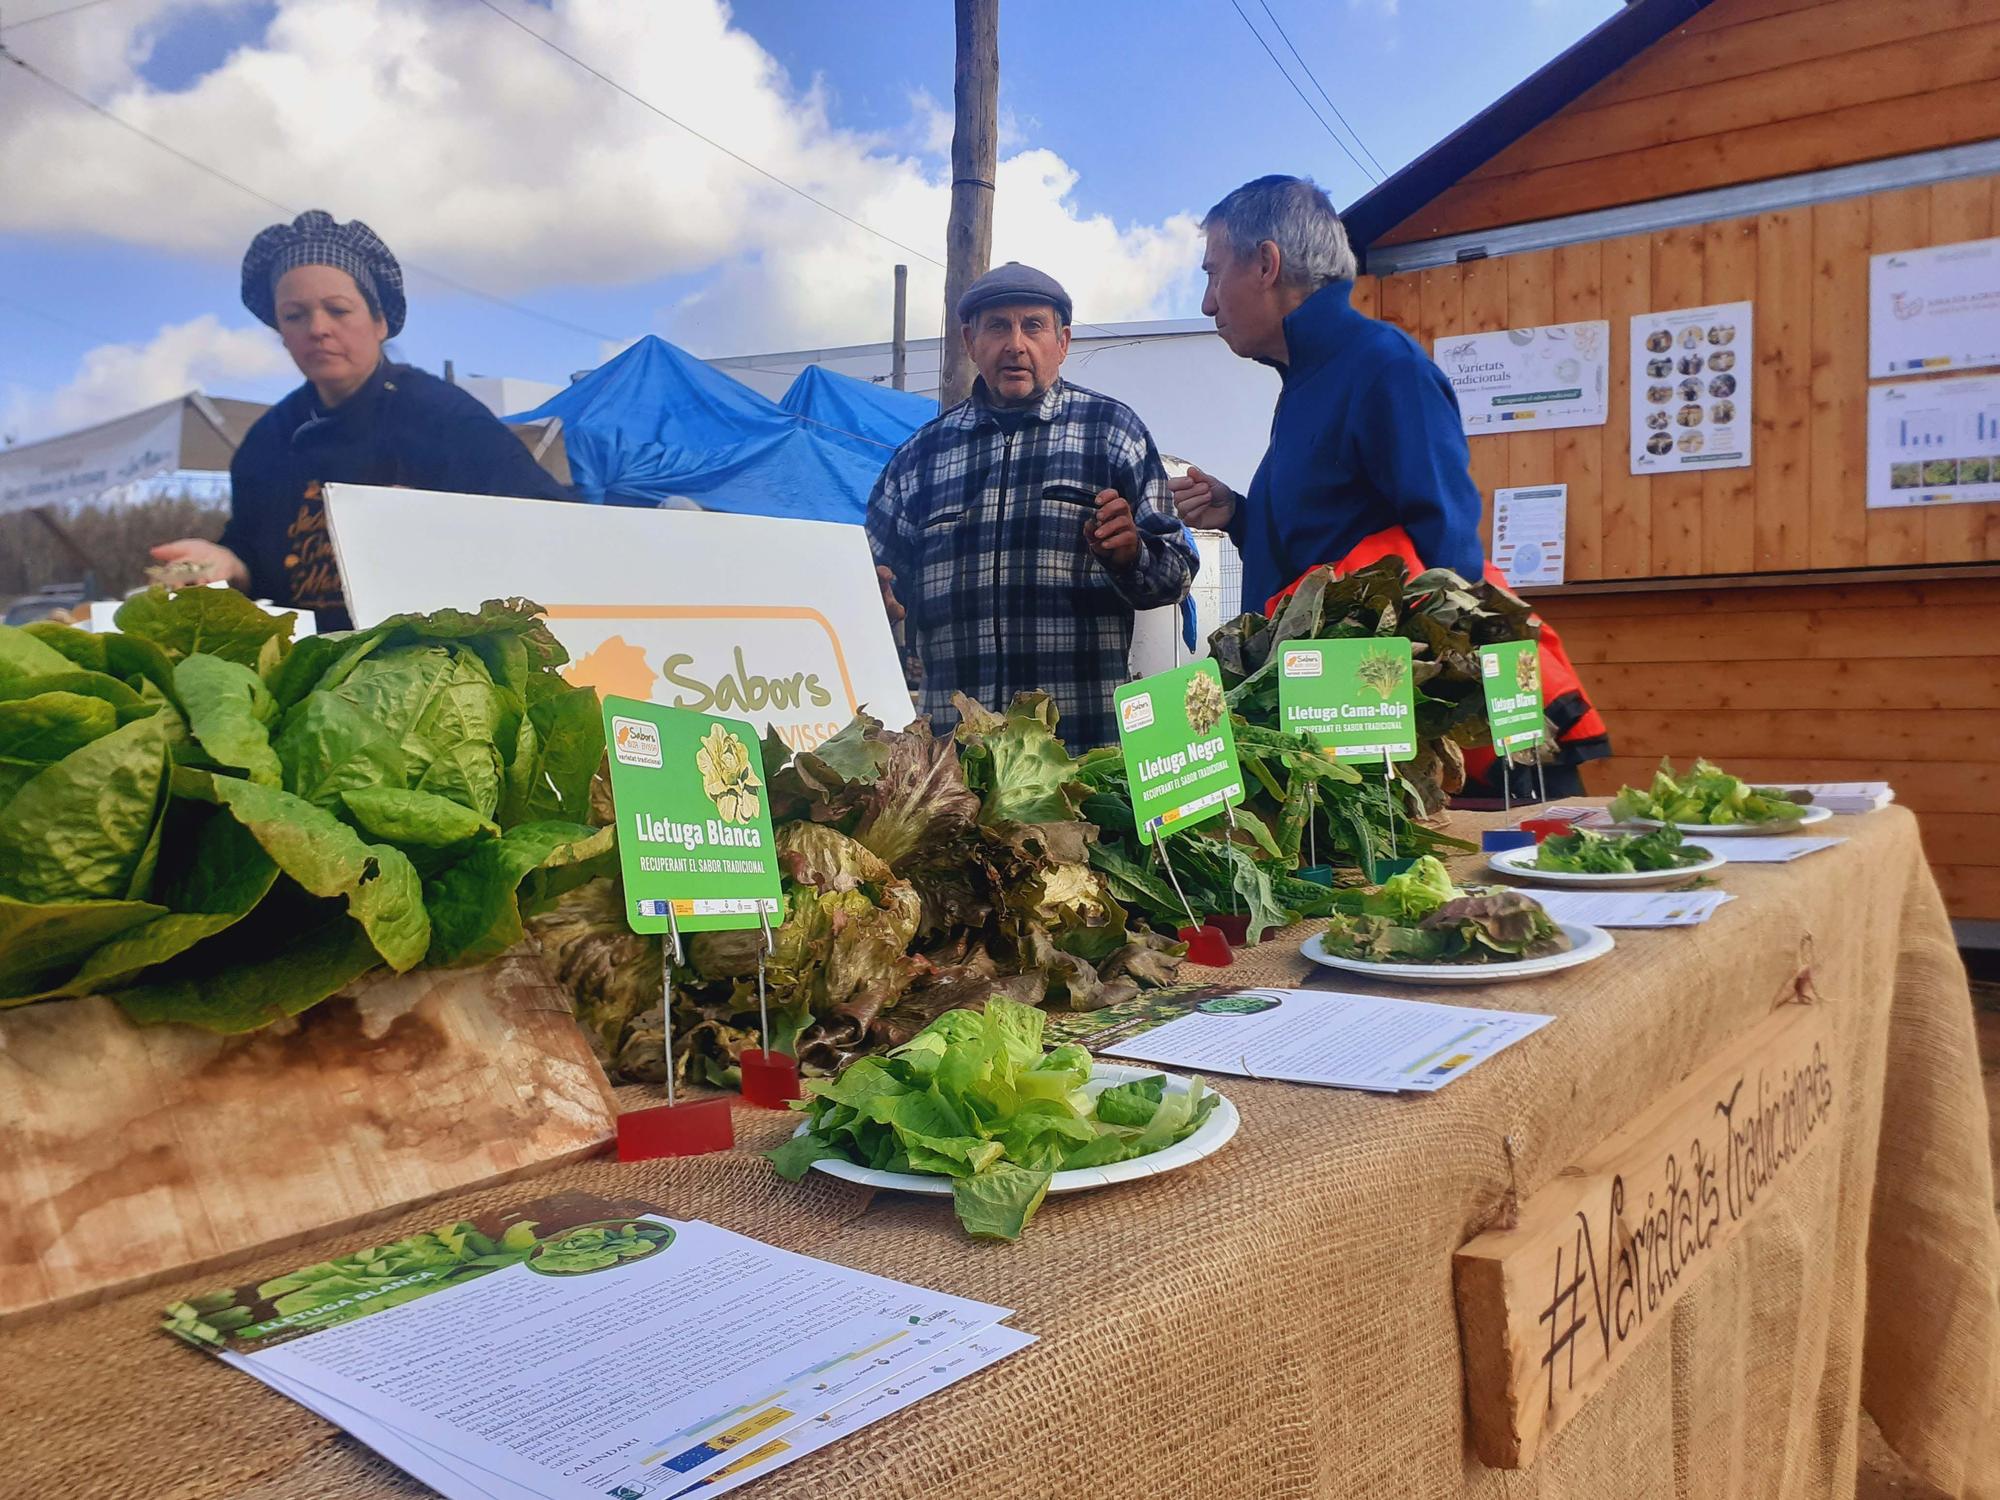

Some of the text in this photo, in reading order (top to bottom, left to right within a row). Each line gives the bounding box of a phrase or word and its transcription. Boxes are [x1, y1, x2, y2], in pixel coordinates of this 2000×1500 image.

[1458, 361, 1505, 374] Varietats
[663, 645, 832, 713] Sabors
[1287, 701, 1408, 721] Lletuga Cama-Roja
[630, 727, 656, 742] Sabors
[1343, 722, 1364, 732] SABOR
[1364, 721, 1403, 731] TRADICIONAL
[1137, 736, 1225, 783] Lletuga Negra
[1180, 771, 1199, 787] SABOR
[1198, 759, 1229, 780] TRADICIONAL
[635, 813, 761, 851] Lletuga Blanca
[640, 856, 765, 874] RECUPERANT EL SABOR TRADICIONAL
[257, 1270, 436, 1333] LLETUGA BLANCA
[559, 1436, 642, 1477] CALENDARI
